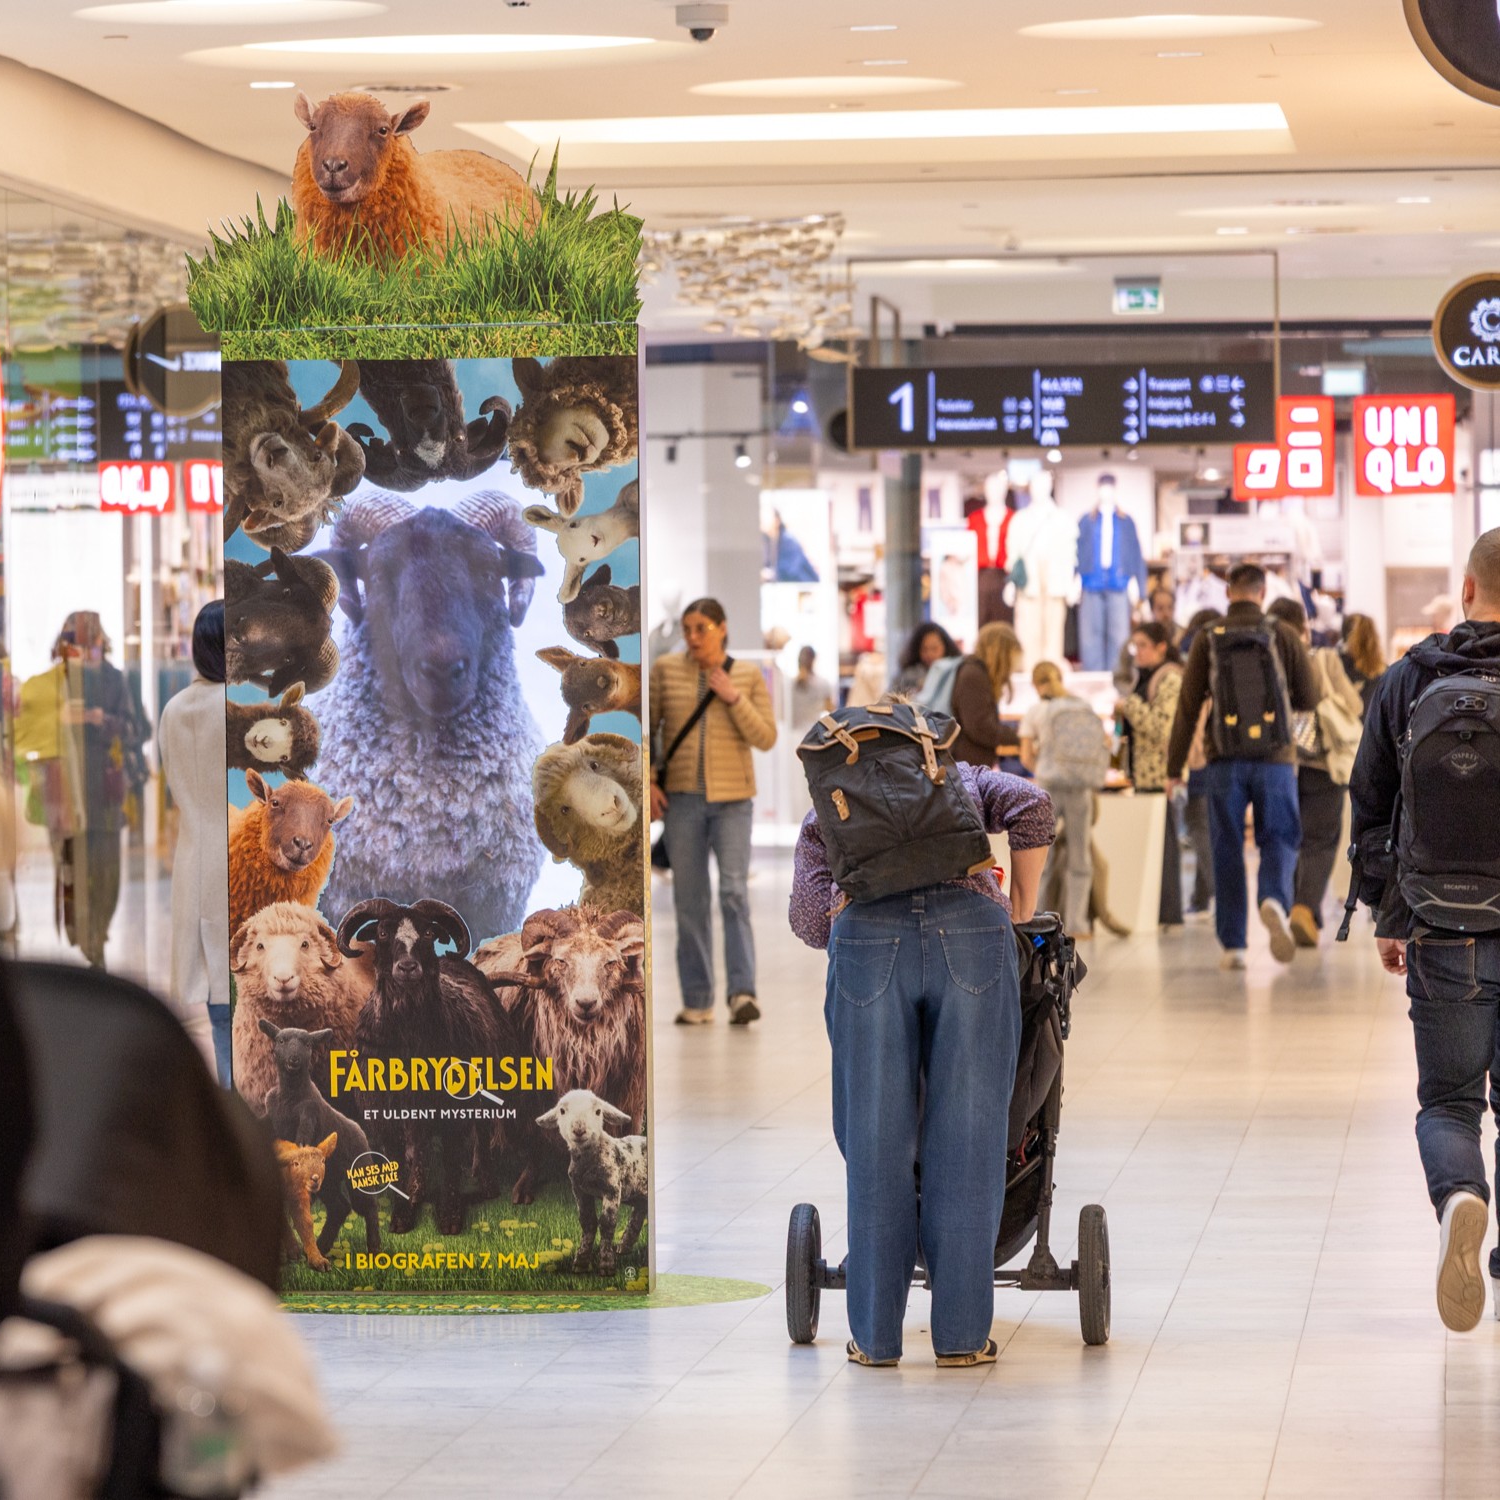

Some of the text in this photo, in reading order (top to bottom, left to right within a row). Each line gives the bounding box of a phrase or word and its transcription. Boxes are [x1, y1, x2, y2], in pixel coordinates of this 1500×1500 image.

[888, 382, 914, 432] 1
[1364, 406, 1438, 446] UNI
[1365, 447, 1446, 494] QLO
[330, 1049, 553, 1098] FÅRBRYDELSEN
[364, 1108, 517, 1120] ET ULDENT MYSTERIUM
[347, 1161, 399, 1179] KAN SES MED
[352, 1171, 399, 1189] DANSK TALE
[345, 1252, 540, 1270] I BIOGRAFEN 7. MAJ
